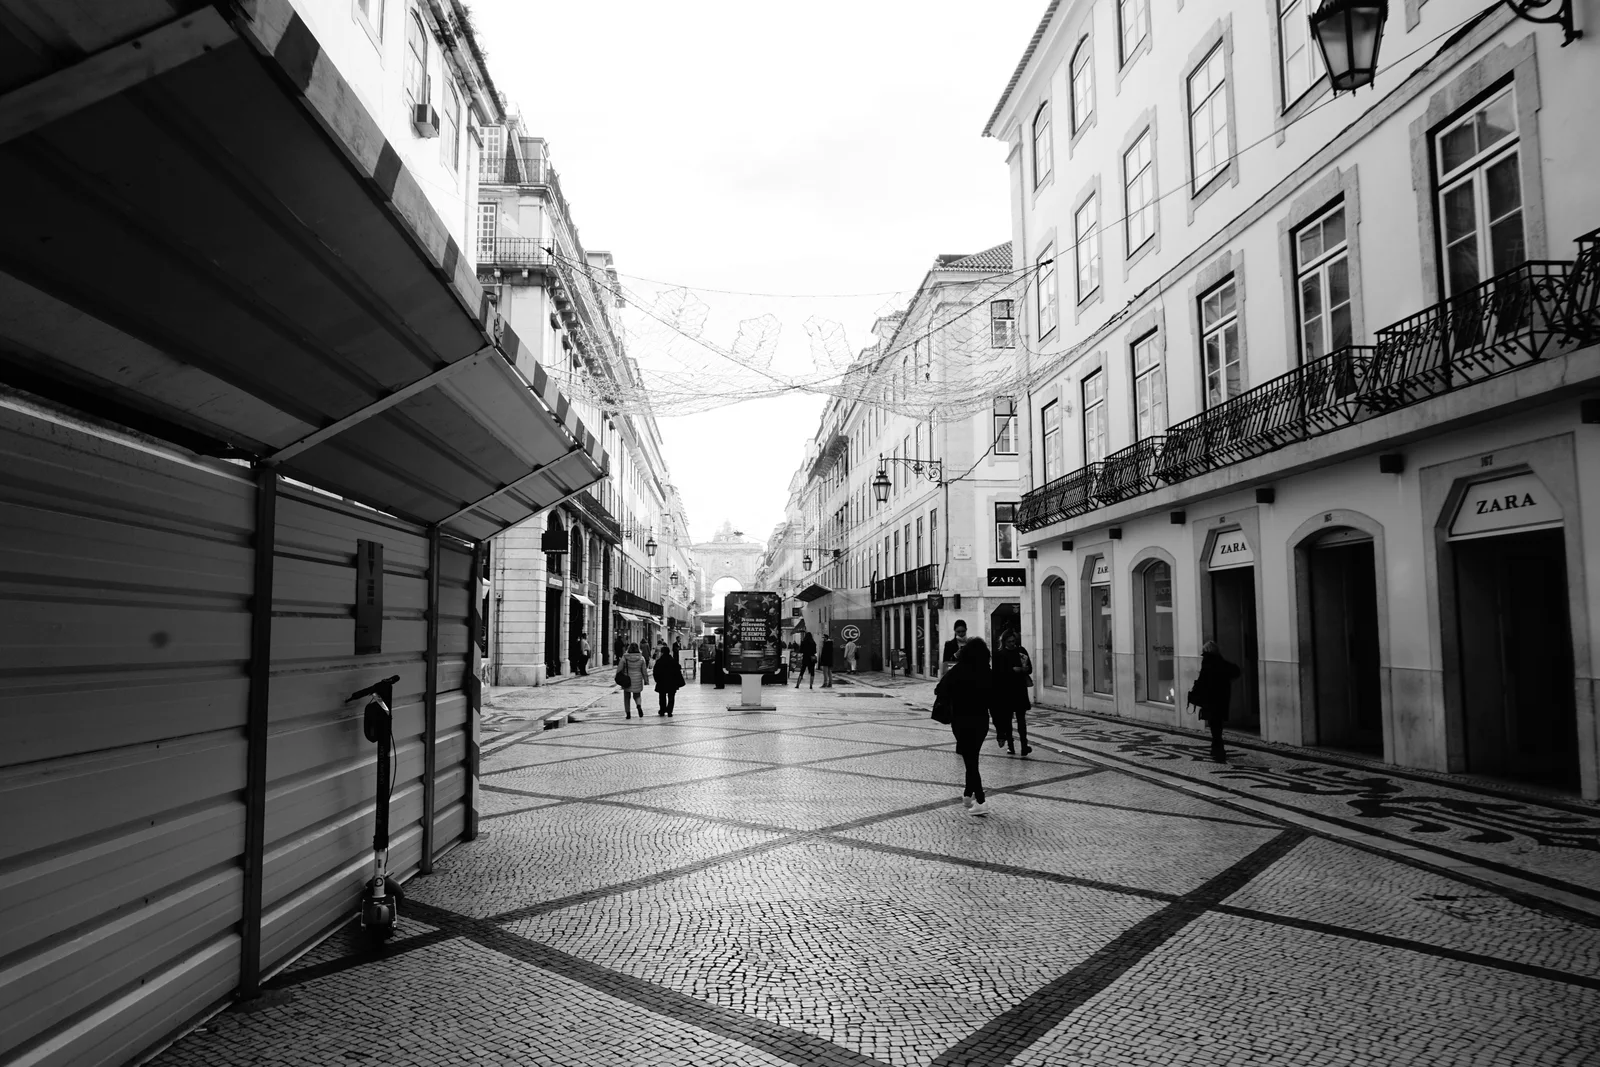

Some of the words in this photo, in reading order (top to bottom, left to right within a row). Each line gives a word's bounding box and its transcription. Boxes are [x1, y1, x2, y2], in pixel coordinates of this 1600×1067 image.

[1476, 493, 1537, 515] ZARA
[1220, 541, 1248, 555] ZARA
[1097, 566, 1109, 575] ZAR
[843, 628, 859, 639] CG
